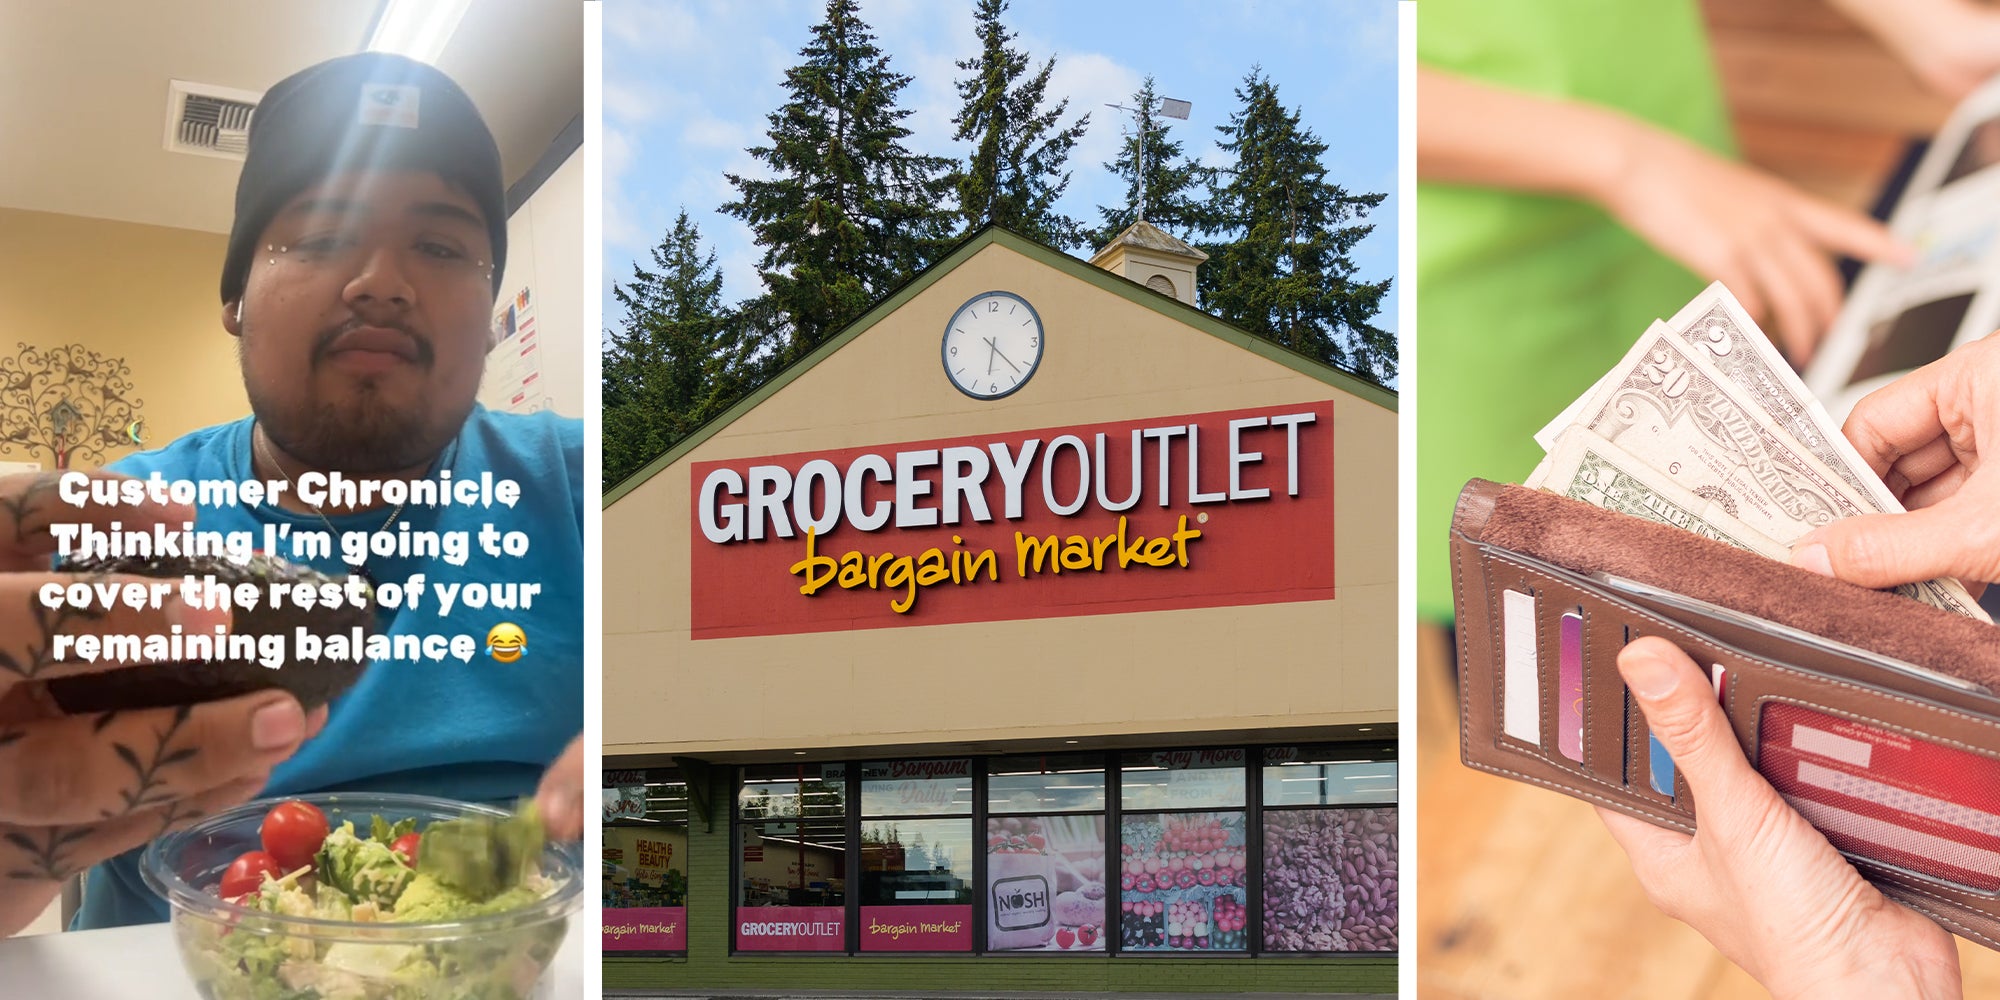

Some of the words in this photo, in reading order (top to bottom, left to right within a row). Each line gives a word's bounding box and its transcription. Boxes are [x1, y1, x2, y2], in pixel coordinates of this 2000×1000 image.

[988, 301, 999, 313] 12
[950, 346, 958, 358] 9
[1030, 336, 1038, 349] 3
[1642, 350, 1690, 399] 20
[990, 382, 998, 394] 6
[1710, 398, 1763, 459] UNITED
[1751, 458, 1806, 518] STATES
[1668, 461, 1682, 475] 6
[698, 412, 1317, 544] GROCERYOUTLET
[789, 525, 998, 614] bargain
[1014, 514, 1202, 577] market
[864, 767, 889, 778] NEW
[636, 839, 667, 855] HEALTH
[639, 852, 670, 869] BEAUTY
[602, 922, 637, 940] argain
[639, 921, 676, 934] market
[741, 922, 840, 936] GROCERYOUTLET
[869, 918, 918, 940] bargain
[919, 919, 960, 934] market
